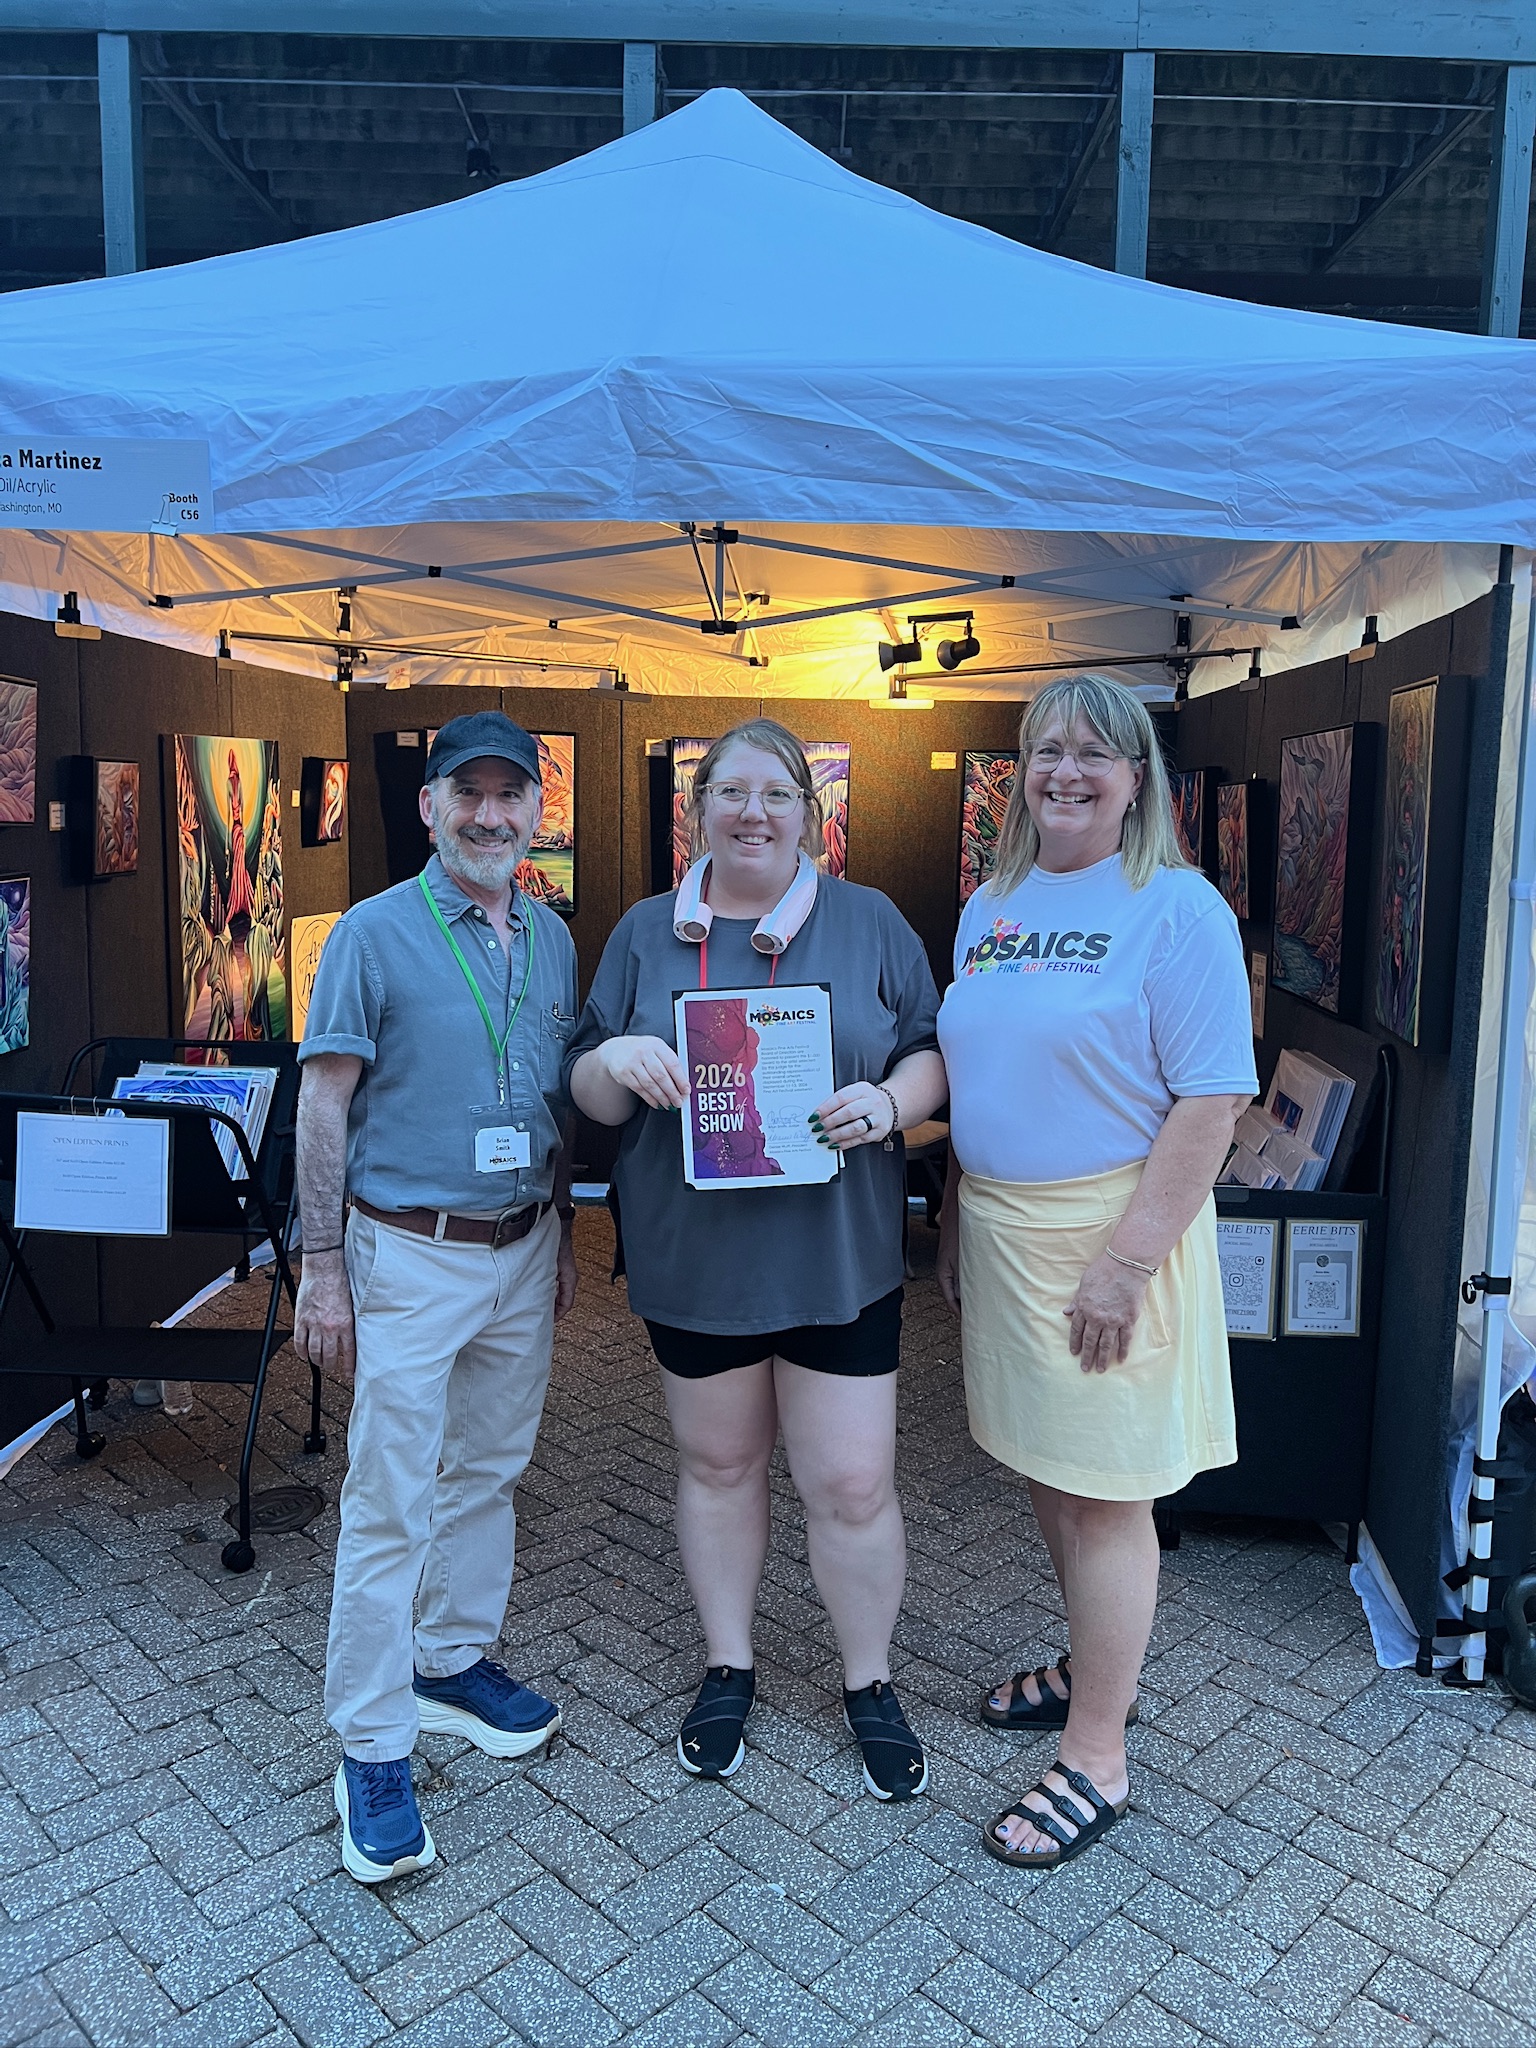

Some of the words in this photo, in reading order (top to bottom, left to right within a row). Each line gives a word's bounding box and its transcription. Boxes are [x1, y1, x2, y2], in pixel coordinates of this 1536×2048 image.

[19, 449, 102, 470] Martinez
[0, 478, 56, 497] Oil/Acrylic
[169, 492, 198, 503] Booth
[0, 502, 45, 515] ashington,
[48, 502, 62, 514] MO
[181, 509, 199, 520] C56
[997, 963, 1021, 973] FINE
[1023, 963, 1044, 973] ART
[1046, 962, 1101, 974] FESTIVAL
[750, 1010, 815, 1023] MOSAICS
[694, 1063, 746, 1088] 2026
[698, 1092, 736, 1111] BEST
[735, 1097, 748, 1115] of
[699, 1114, 744, 1133] SHOW
[73, 1138, 103, 1146] EDITION
[104, 1139, 129, 1147] PRINTS
[1217, 1224, 1243, 1234] ERIE
[1246, 1225, 1271, 1236] BITS
[1293, 1226, 1327, 1236] EERIE
[1330, 1227, 1356, 1236] BITS
